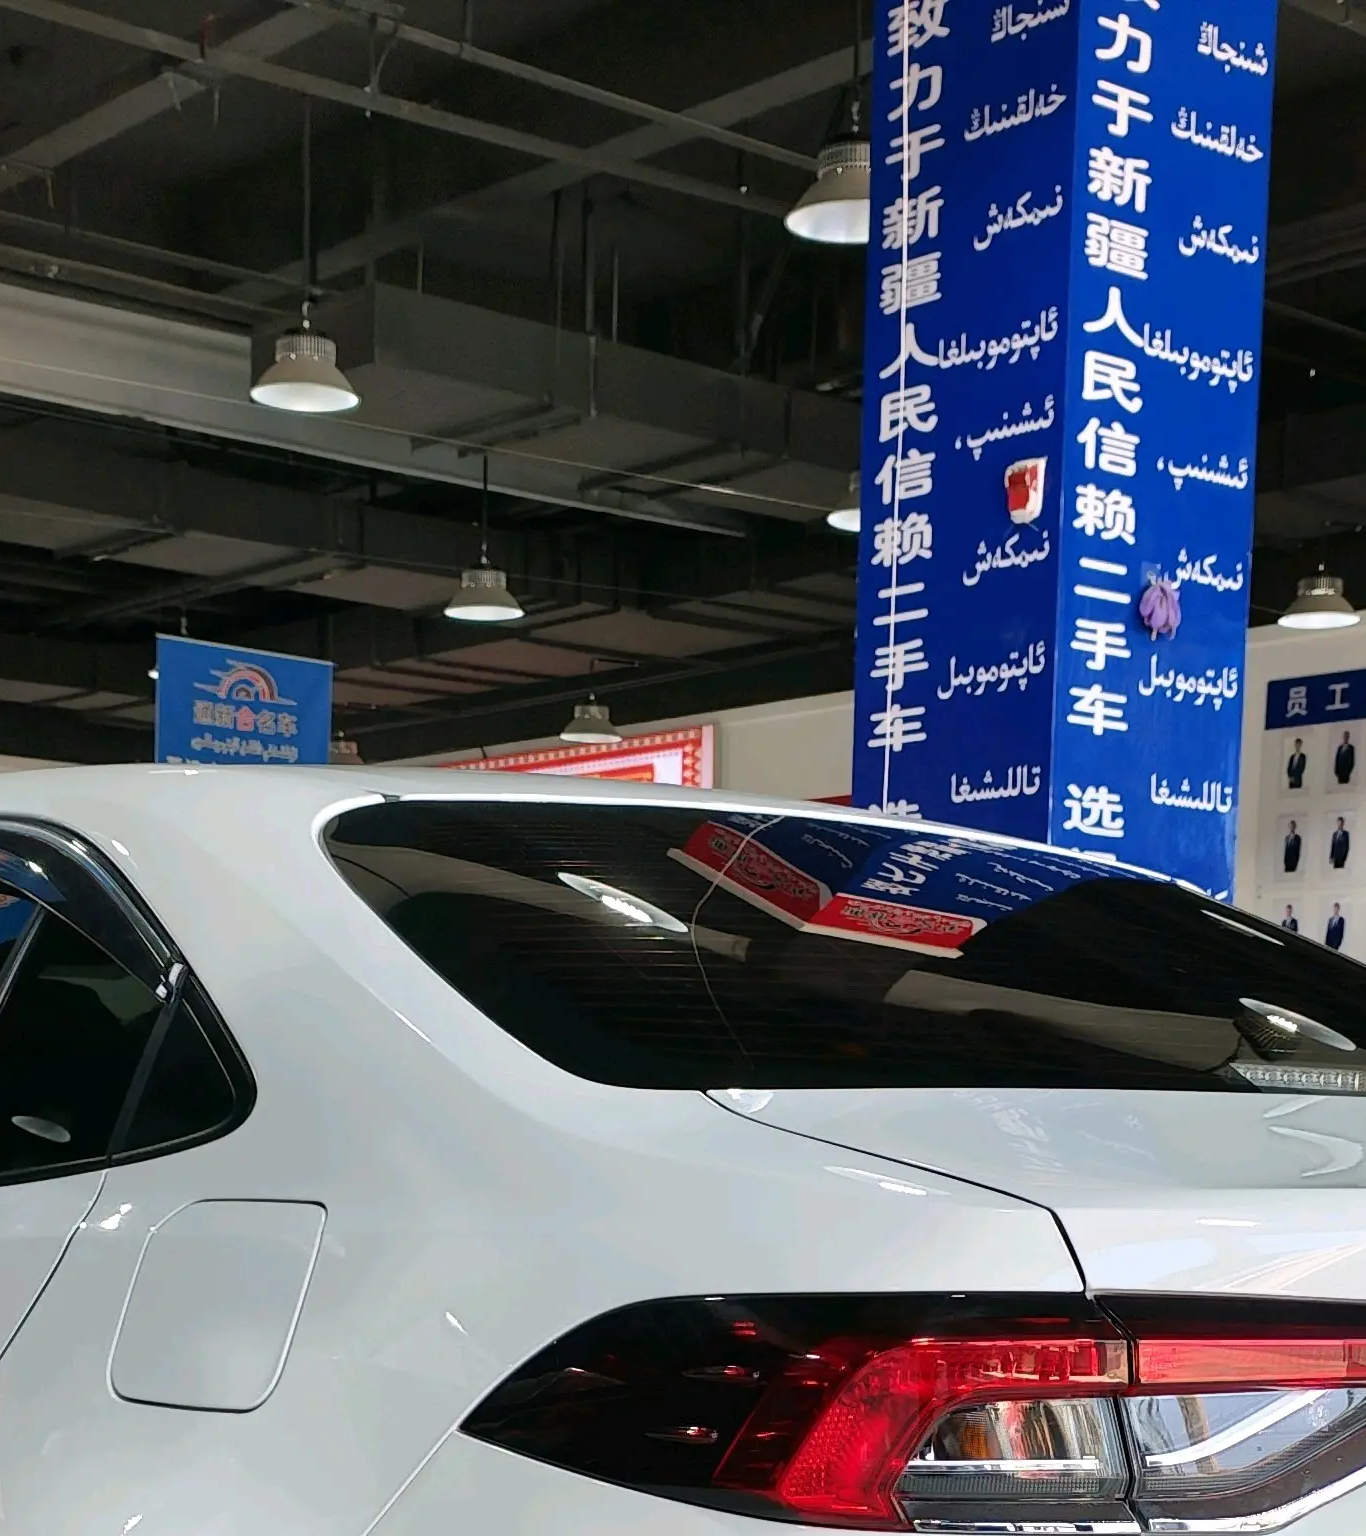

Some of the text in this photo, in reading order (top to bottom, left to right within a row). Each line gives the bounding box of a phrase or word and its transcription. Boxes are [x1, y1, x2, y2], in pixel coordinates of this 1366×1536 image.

[1063, 0, 1161, 863] 力于新疆人民信赖二手车 选
